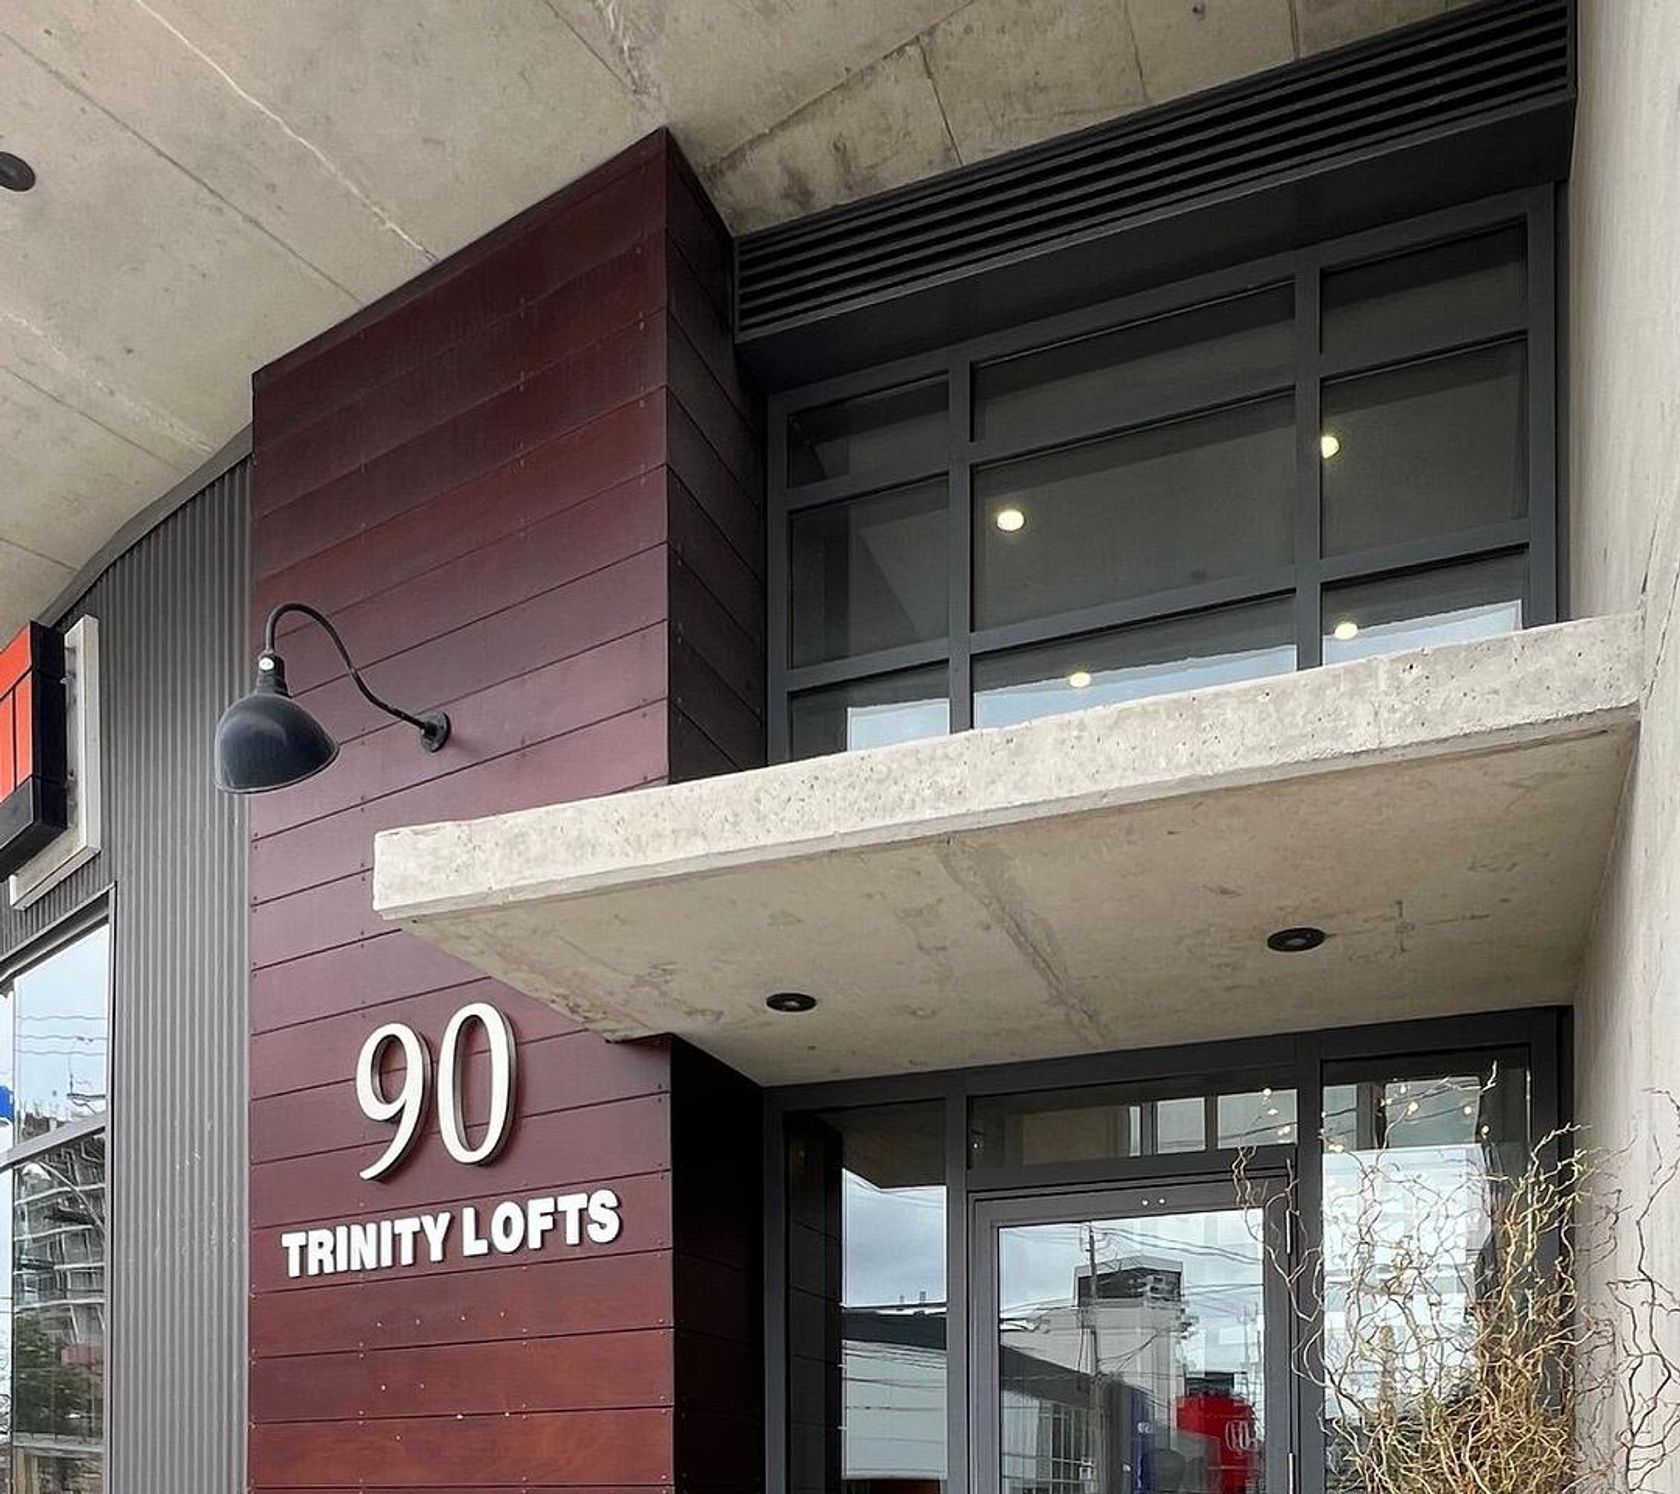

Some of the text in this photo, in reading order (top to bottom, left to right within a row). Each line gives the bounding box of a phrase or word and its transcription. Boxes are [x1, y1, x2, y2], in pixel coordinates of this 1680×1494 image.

[356, 1002, 517, 1181] 90
[281, 1188, 622, 1279] TRINITY LOFTS
